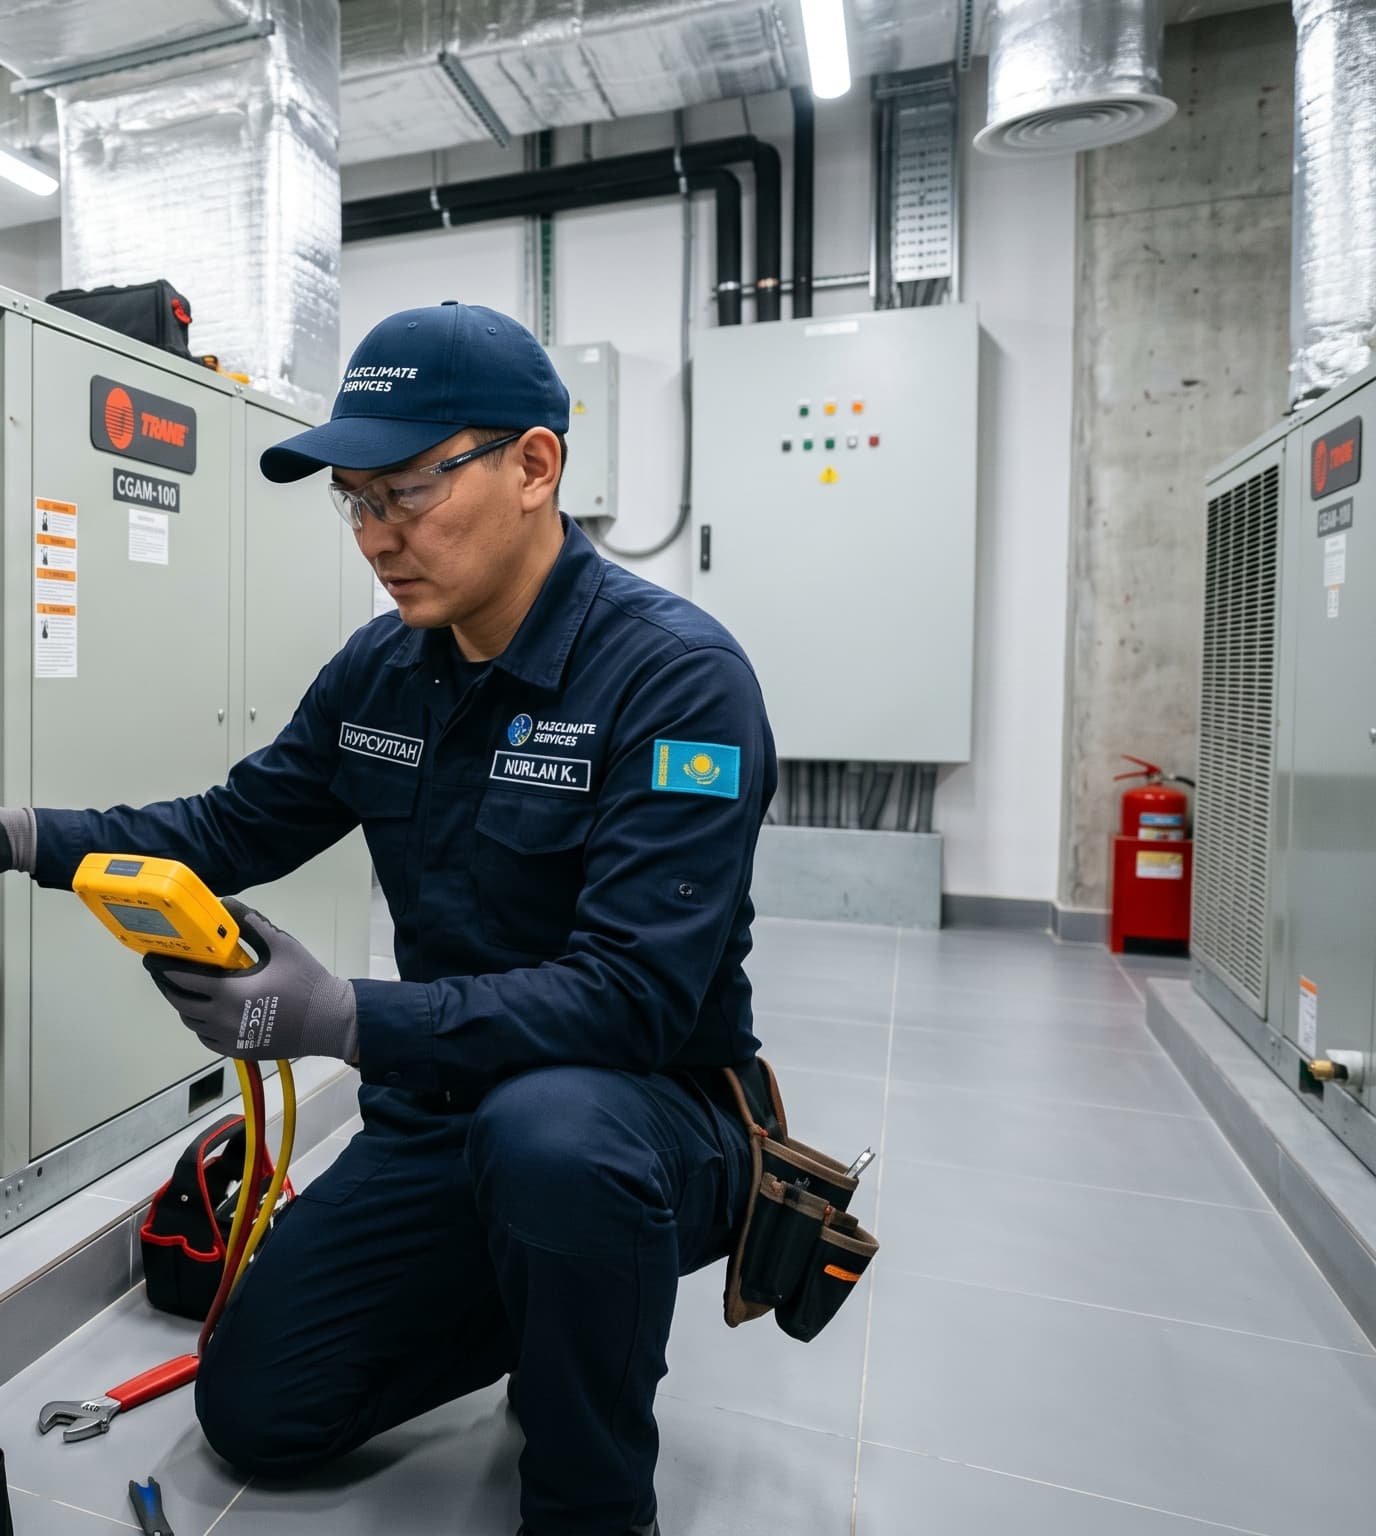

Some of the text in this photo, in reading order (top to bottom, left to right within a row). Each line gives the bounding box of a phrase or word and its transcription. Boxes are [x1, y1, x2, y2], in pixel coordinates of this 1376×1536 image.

[140, 412, 186, 448] TRANE
[116, 475, 177, 507] CGAM-100
[344, 728, 418, 761] НУРСУЛТАН
[504, 758, 577, 783] NURLAN K.
